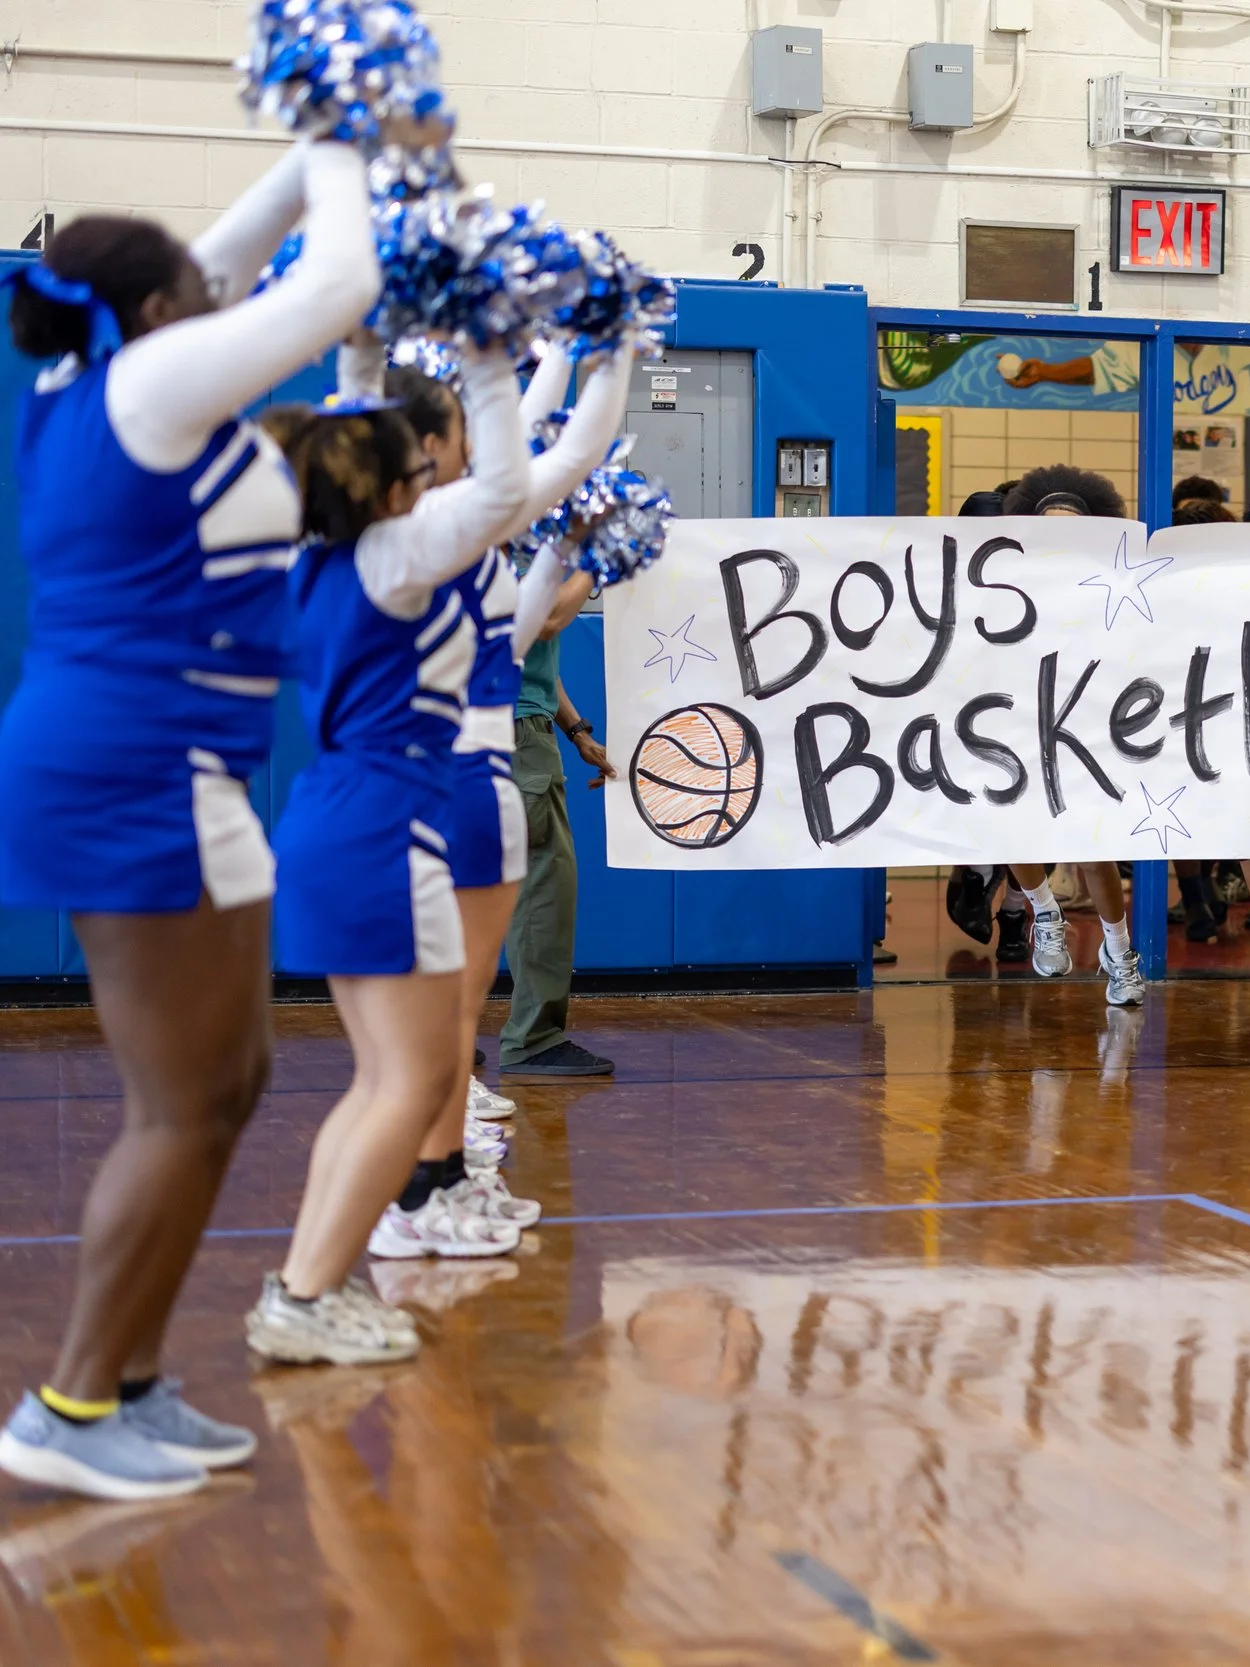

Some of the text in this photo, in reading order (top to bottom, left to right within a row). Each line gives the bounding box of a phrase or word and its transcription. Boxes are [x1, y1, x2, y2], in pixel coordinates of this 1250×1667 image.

[21, 213, 55, 250] 4
[1130, 199, 1218, 268] EXIT
[732, 243, 765, 280] 2
[1088, 261, 1103, 311] 1
[720, 534, 1037, 700] Boys
